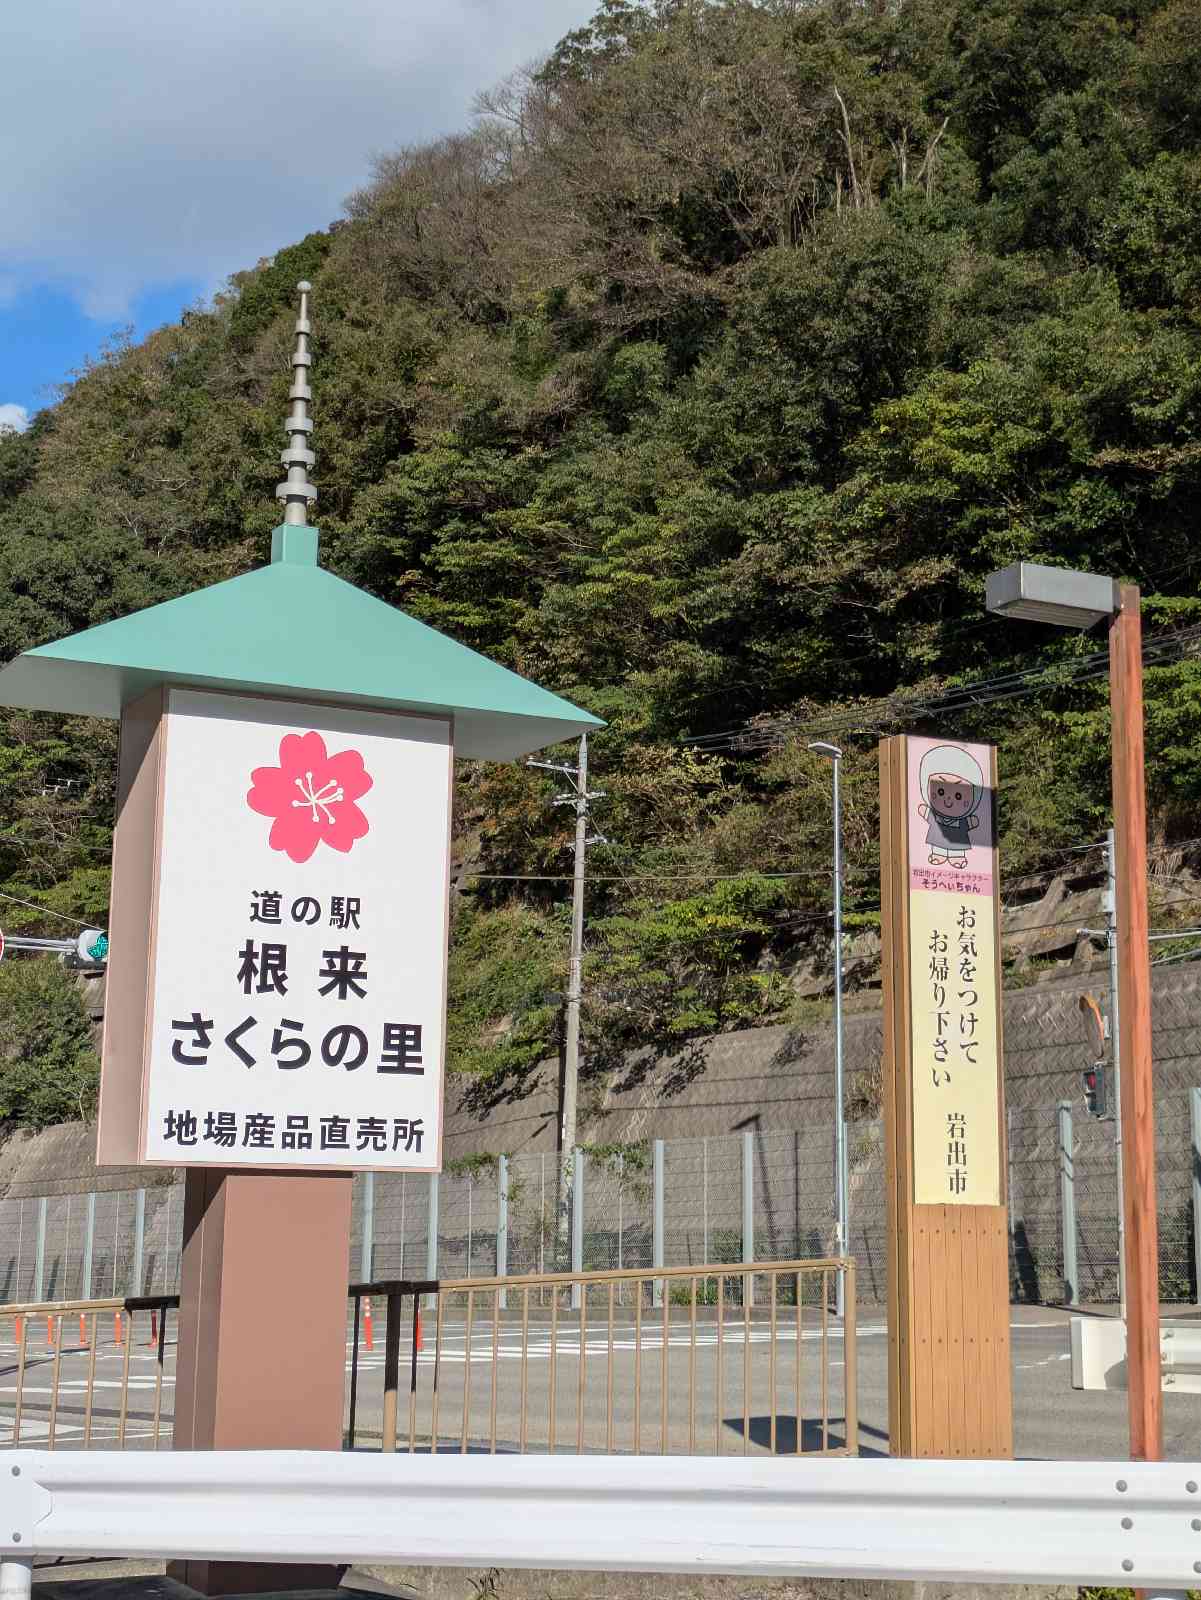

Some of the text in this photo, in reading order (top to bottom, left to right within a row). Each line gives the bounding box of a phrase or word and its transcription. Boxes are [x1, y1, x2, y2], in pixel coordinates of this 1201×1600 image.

[249, 890, 361, 930] 道の駅
[921, 878, 980, 893] そうへいちゃん
[928, 929, 951, 1087] お帰り下さい
[956, 904, 979, 1064] お気をつけて
[171, 1012, 425, 1076] さくらの里
[163, 1109, 425, 1153] 地場産品直売所
[946, 1112, 968, 1195] 岩出市
